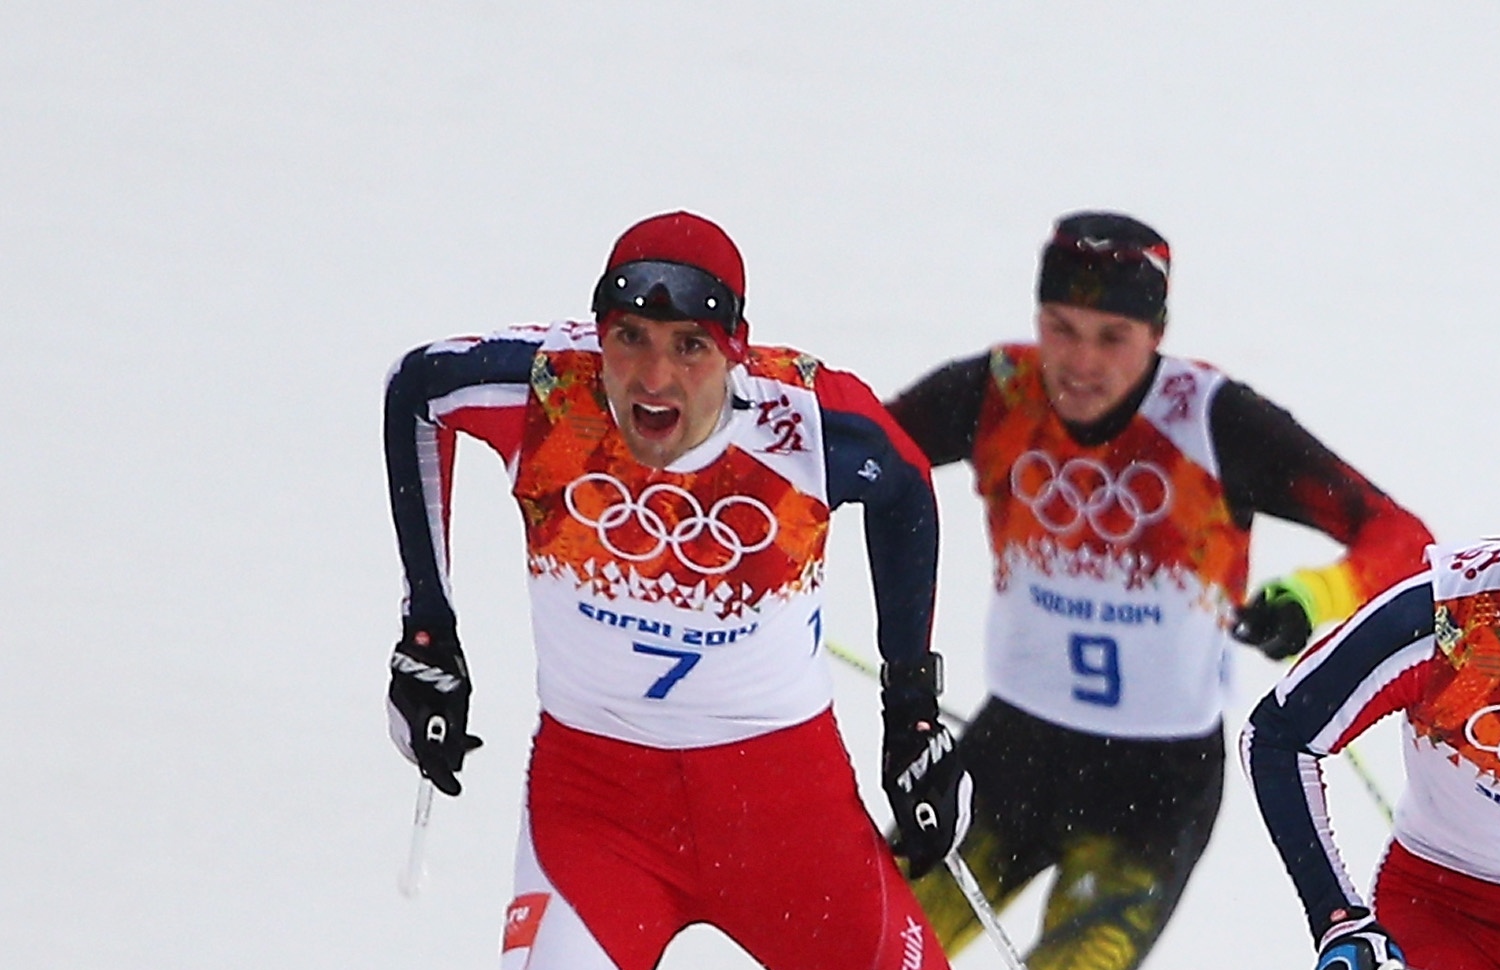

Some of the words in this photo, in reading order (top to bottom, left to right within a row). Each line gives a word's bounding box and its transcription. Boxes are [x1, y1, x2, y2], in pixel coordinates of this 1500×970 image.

[1101, 602, 1162, 624] 2014
[631, 641, 702, 700] 7
[1069, 633, 1121, 707] 9
